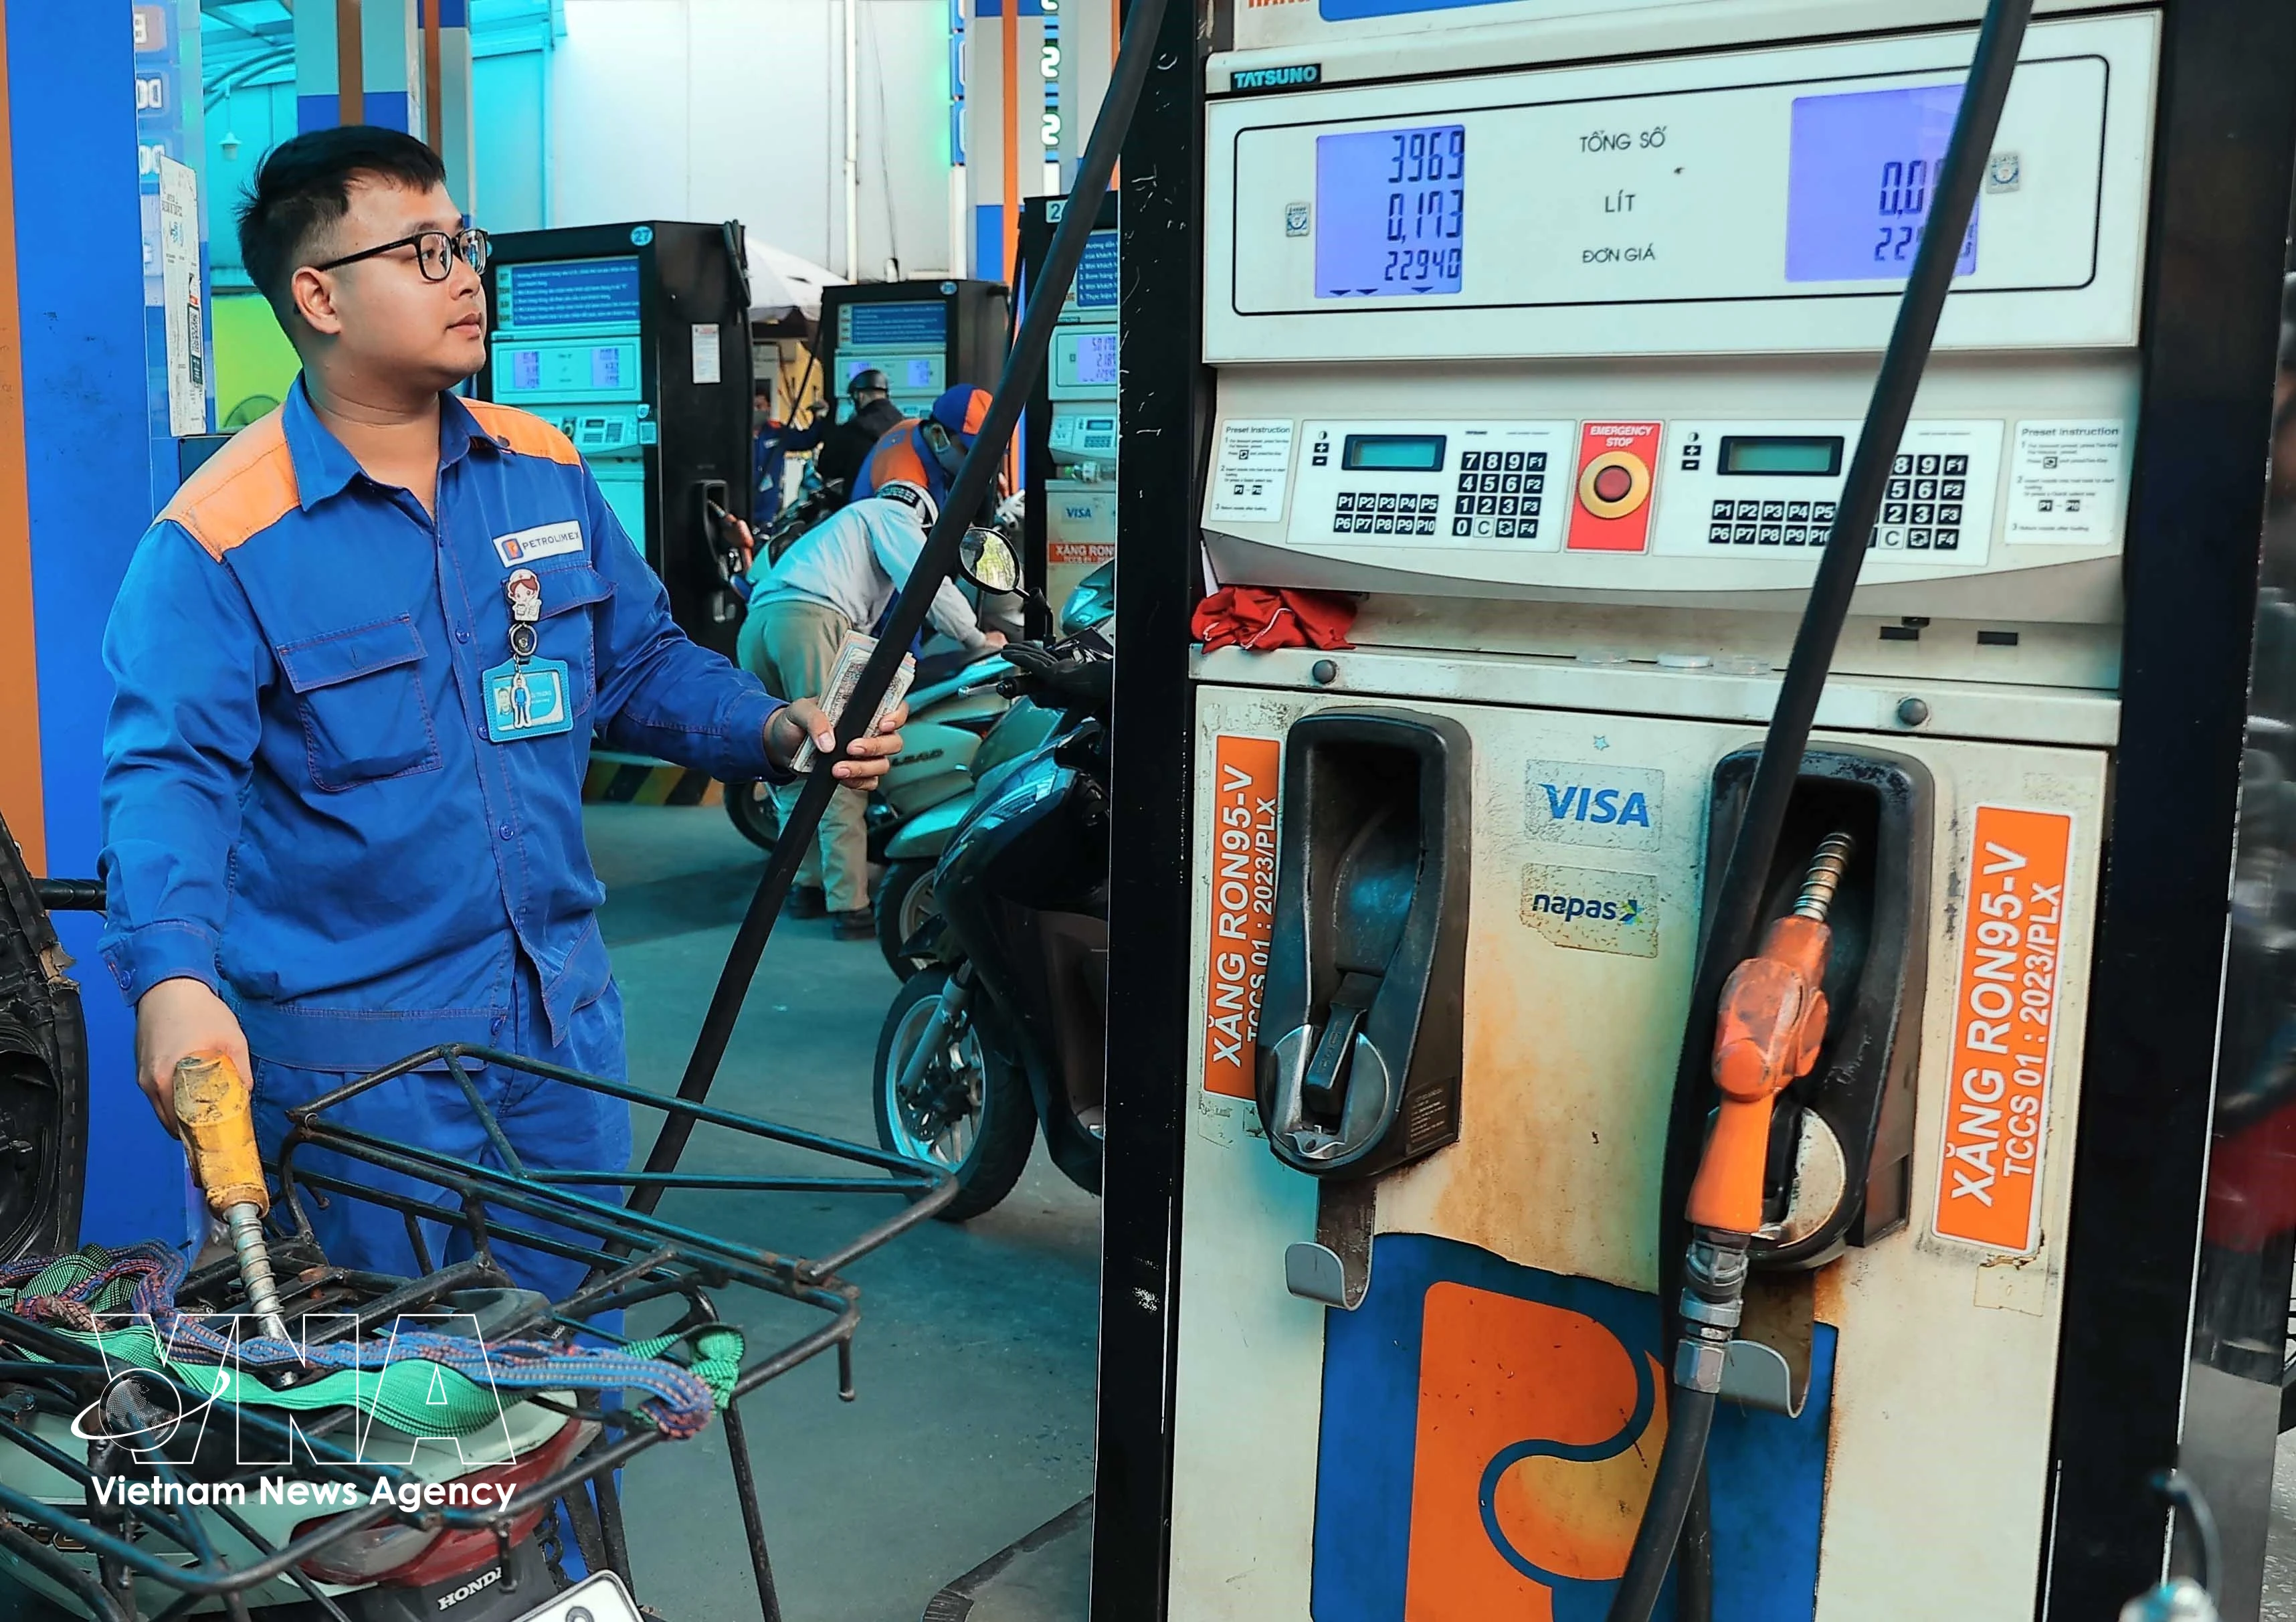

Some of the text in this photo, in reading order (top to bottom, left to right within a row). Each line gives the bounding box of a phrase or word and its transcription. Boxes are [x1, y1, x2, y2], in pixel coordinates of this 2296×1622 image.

[1234, 66, 1317, 88] TATSUNO
[1580, 126, 1667, 153] TỔNG SỐ
[1390, 130, 1464, 183] 3969
[1604, 191, 1636, 213] LÍT
[1388, 189, 1464, 242] 0,173
[1582, 242, 1656, 263] ĐƠN GIÁ
[1384, 248, 1462, 282] 22940
[1590, 426, 1653, 436] EMERGENCY
[2022, 428, 2056, 436] Preset
[1606, 437, 1632, 448] STOP
[1466, 454, 1543, 468] 7 8 9 F1
[1895, 457, 1964, 473] 8 9 F1
[1462, 476, 1541, 491] 4 5 6 F2
[1891, 482, 1962, 497] 5 6 F2
[1065, 507, 1092, 518] VISA
[1339, 497, 1436, 509] P1 P2 P3 P4 P5
[1461, 498, 1538, 513] 1 2 3 F3
[1715, 504, 1834, 519] P1 P2 P3 P4 P5
[1888, 506, 1959, 522] 2 3 F3
[1336, 518, 1433, 531] P6 P7 P8 P9 P10
[1457, 520, 1535, 535] 0 C F4
[1712, 527, 1729, 539] P6
[1736, 528, 1754, 540] P7
[1761, 529, 1779, 541] P8
[1786, 529, 1804, 541] P9
[522, 531, 580, 550] PETROLIMEX
[1885, 531, 1955, 546] C F4
[1537, 783, 1650, 828] VISA
[1218, 763, 1254, 940] RON95-V
[1252, 797, 1278, 915] 2023/PLX
[1532, 893, 1618, 922] napas
[2019, 882, 2062, 1027] 2023/PLX
[1207, 952, 1245, 1068] XĂNG
[1944, 840, 2029, 1207] XĂNG RON95-V
[2012, 1053, 2043, 1087] 01
[2002, 1093, 2040, 1178] TCCS
